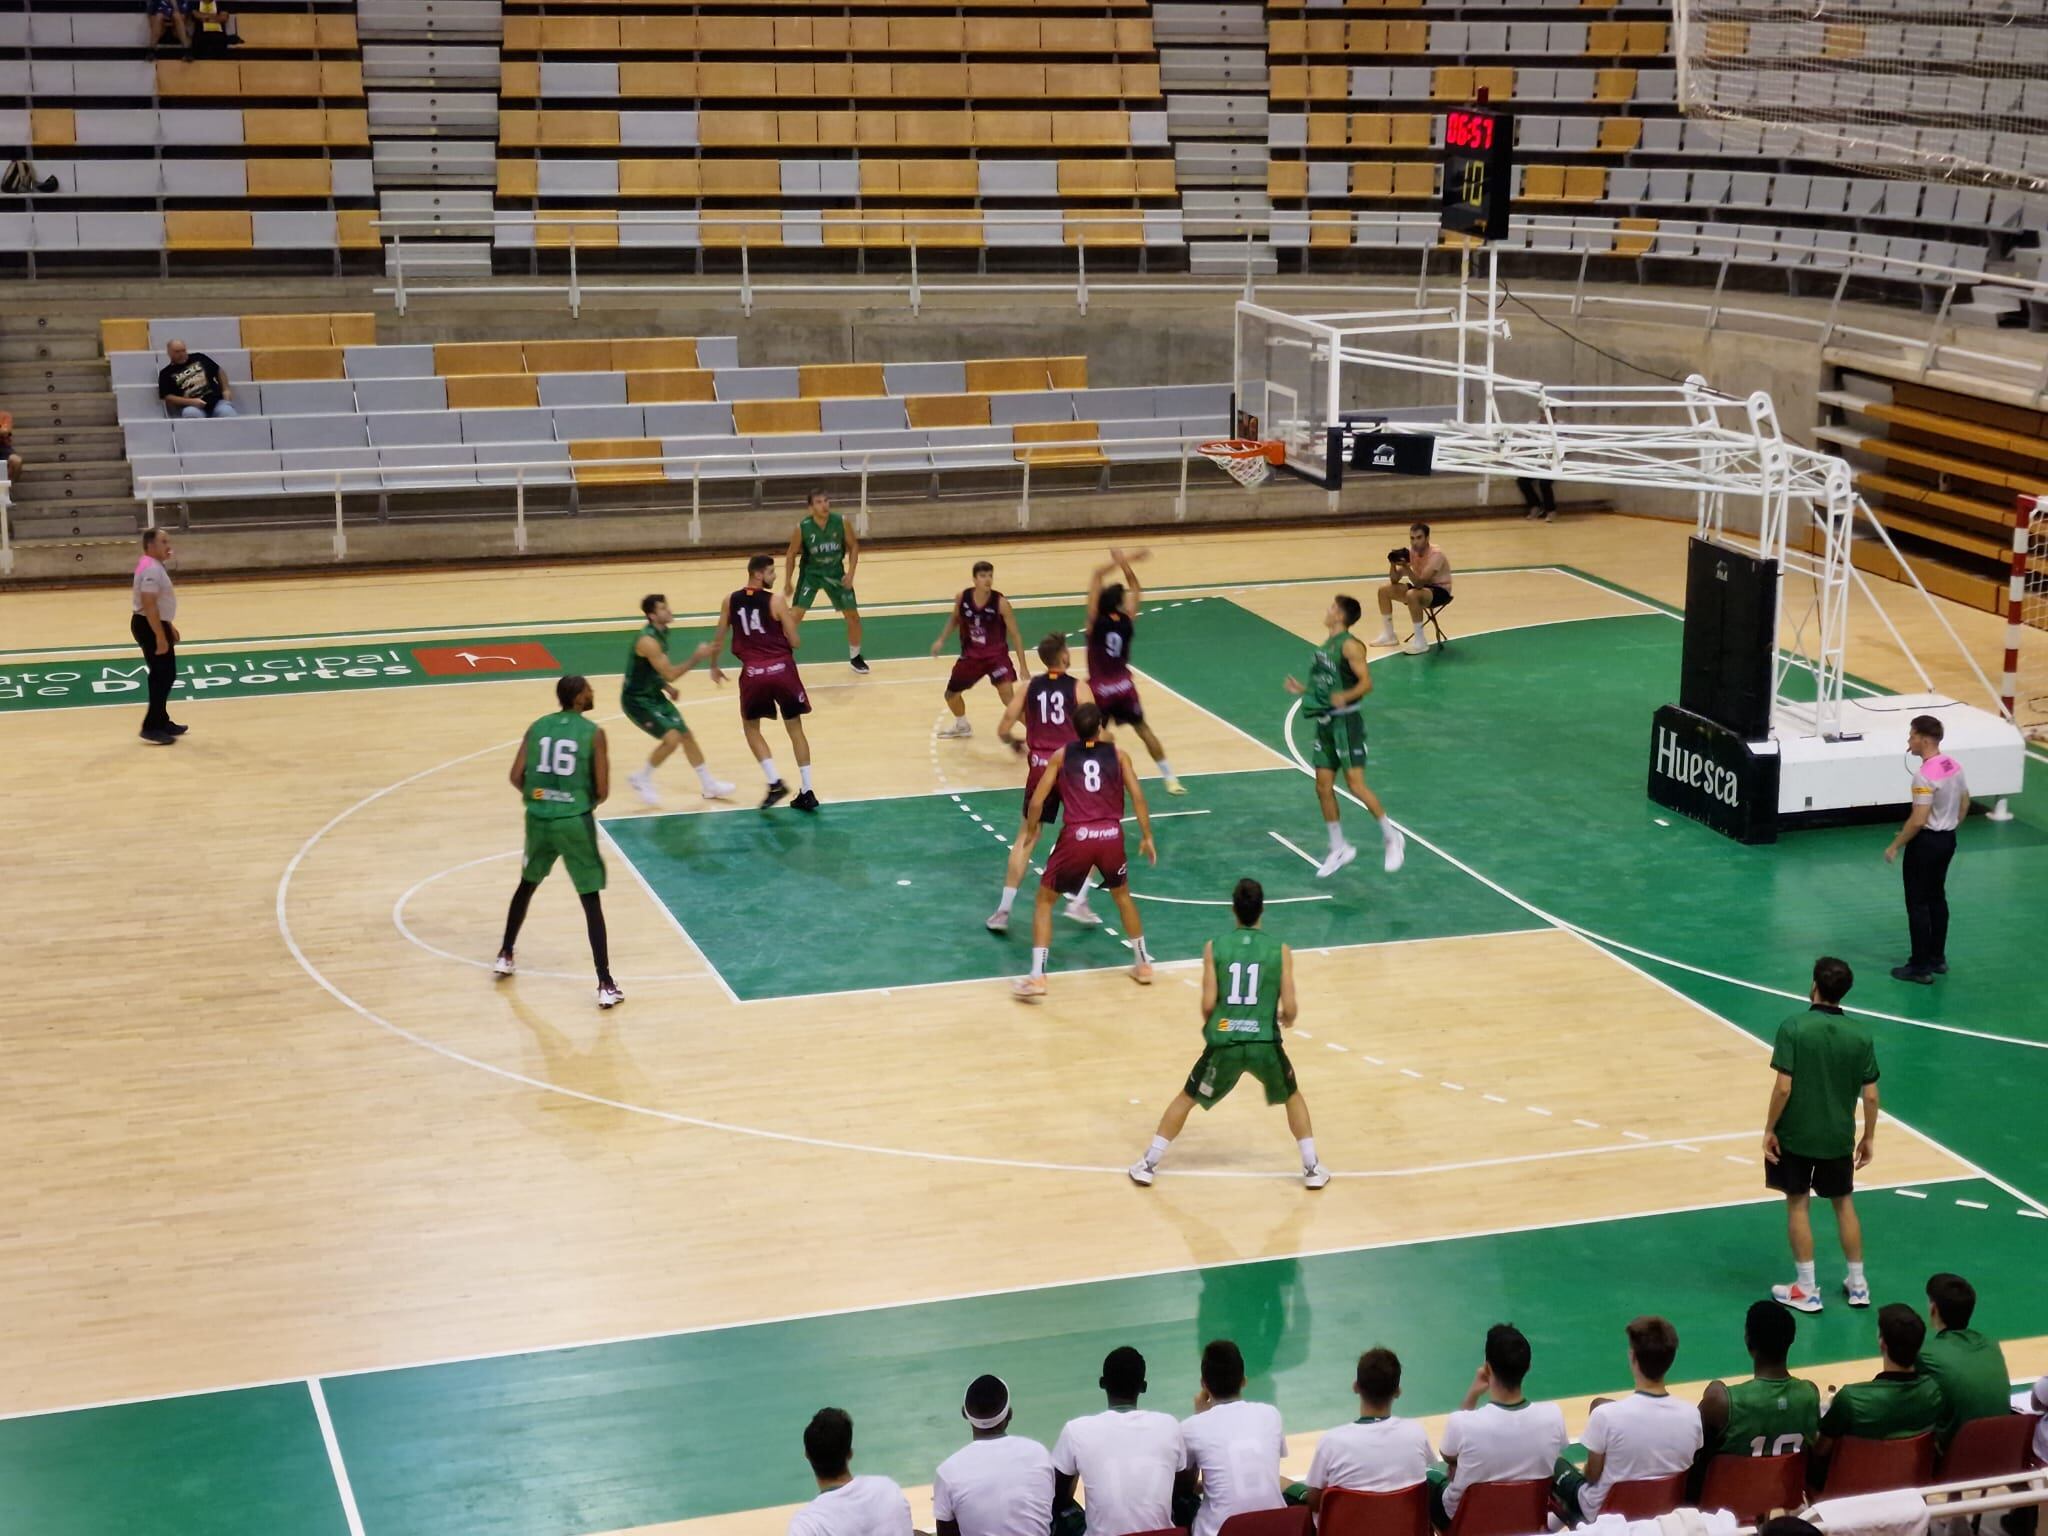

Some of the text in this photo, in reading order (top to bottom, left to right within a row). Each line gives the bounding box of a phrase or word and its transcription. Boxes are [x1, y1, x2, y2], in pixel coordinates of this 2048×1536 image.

[1446, 112, 1495, 150] 06:57
[737, 607, 766, 636] 14
[1105, 631, 1123, 658] 9
[1037, 690, 1065, 725] 13
[536, 736, 578, 776] 16
[1655, 726, 1739, 808] Huesca
[1083, 759, 1101, 792] 8
[1227, 962, 1259, 1005] 11
